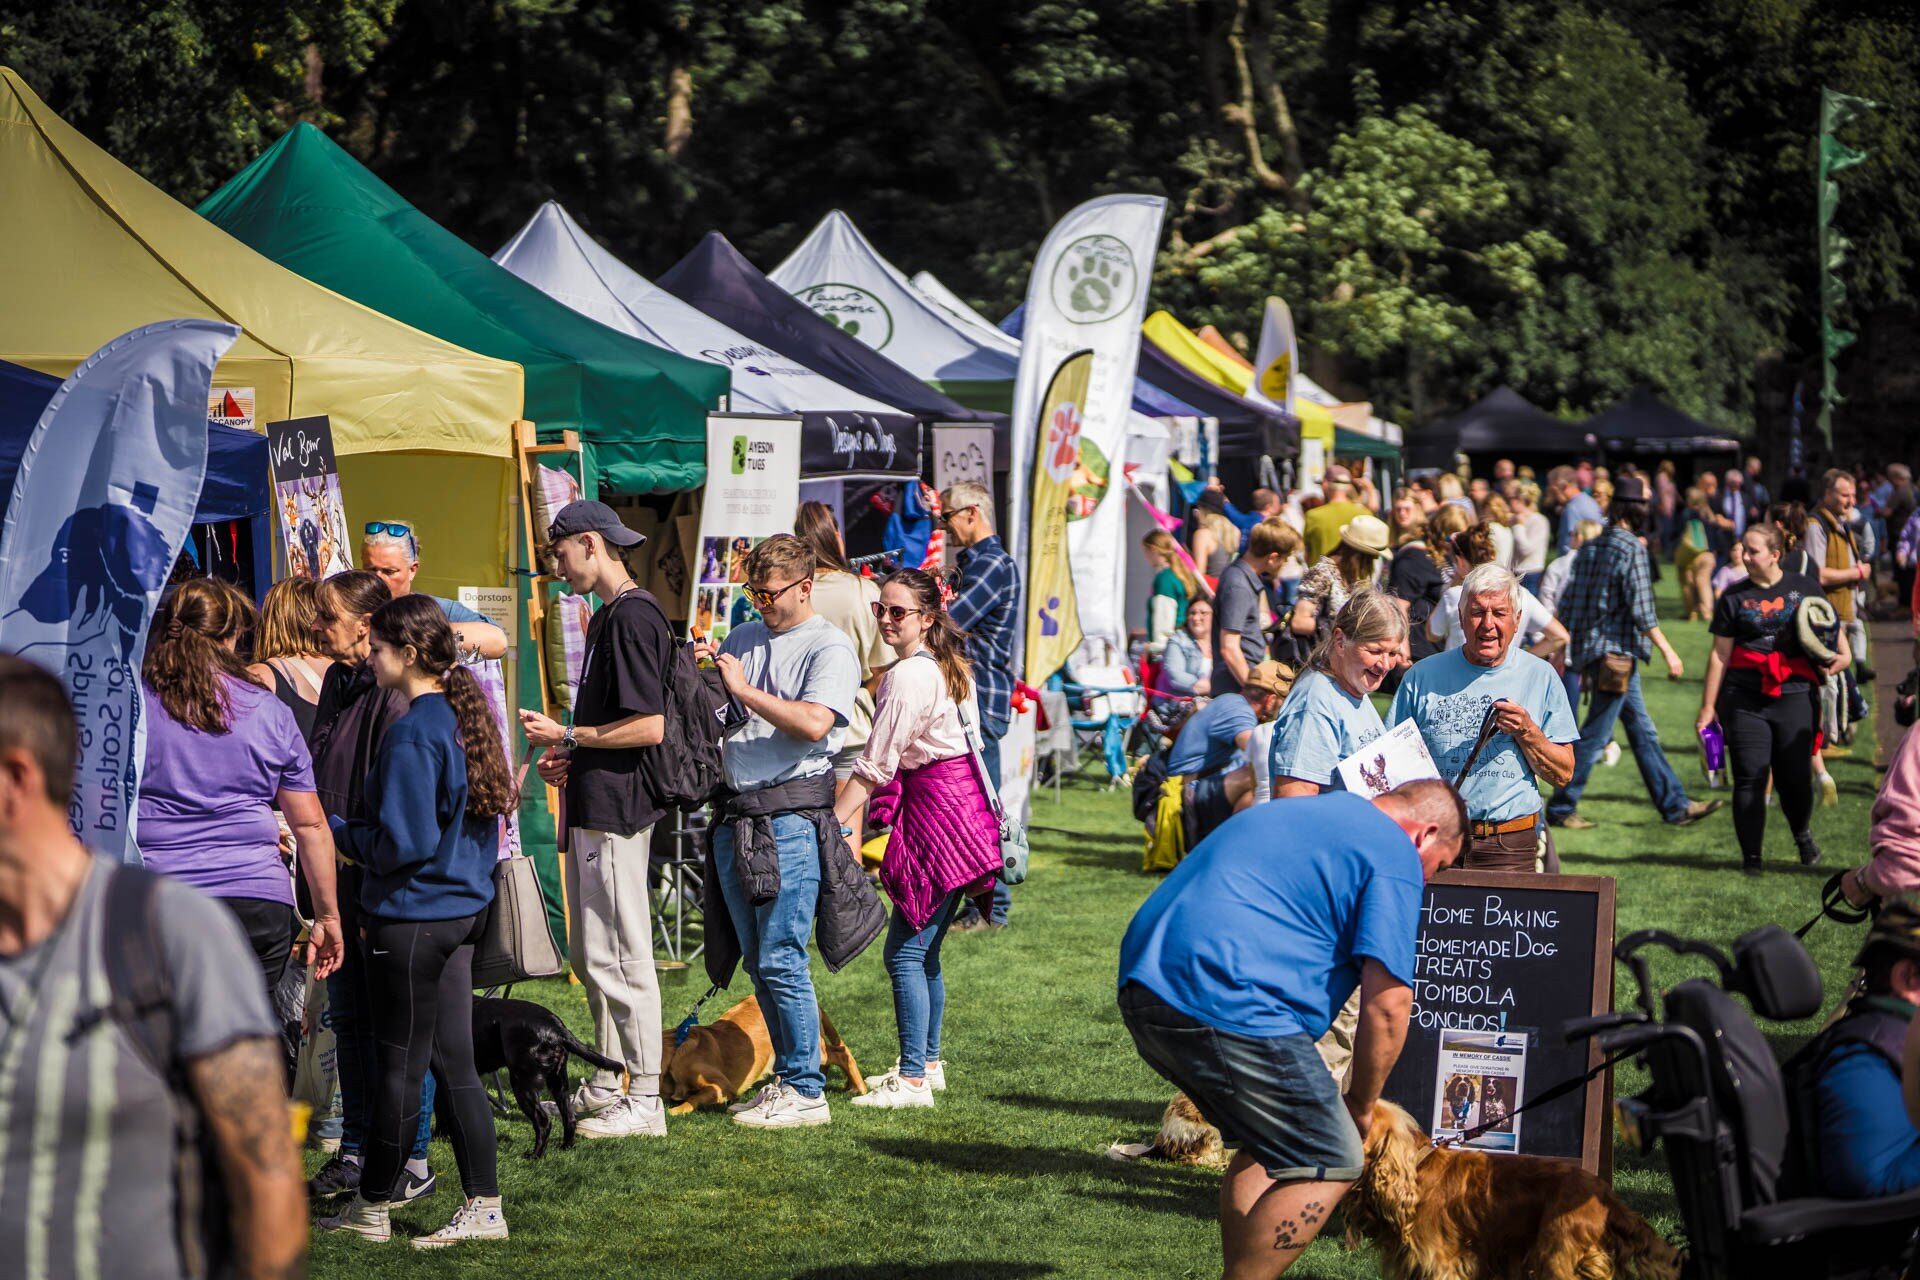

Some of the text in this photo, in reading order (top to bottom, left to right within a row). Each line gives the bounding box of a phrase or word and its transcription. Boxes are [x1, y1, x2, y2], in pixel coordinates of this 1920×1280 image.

[273, 432, 295, 467] Val
[748, 441, 775, 453] AYESON
[747, 458, 765, 470] TUGS
[465, 592, 512, 603] Doorstops
[1474, 769, 1500, 777] Foster
[1502, 769, 1516, 779] Club
[1484, 895, 1560, 928] BAKING
[1515, 931, 1558, 958] DOG
[1414, 954, 1492, 980] TREATS
[1412, 979, 1515, 1006] TOMBOLA
[1408, 1002, 1507, 1032] PONCHOS!
